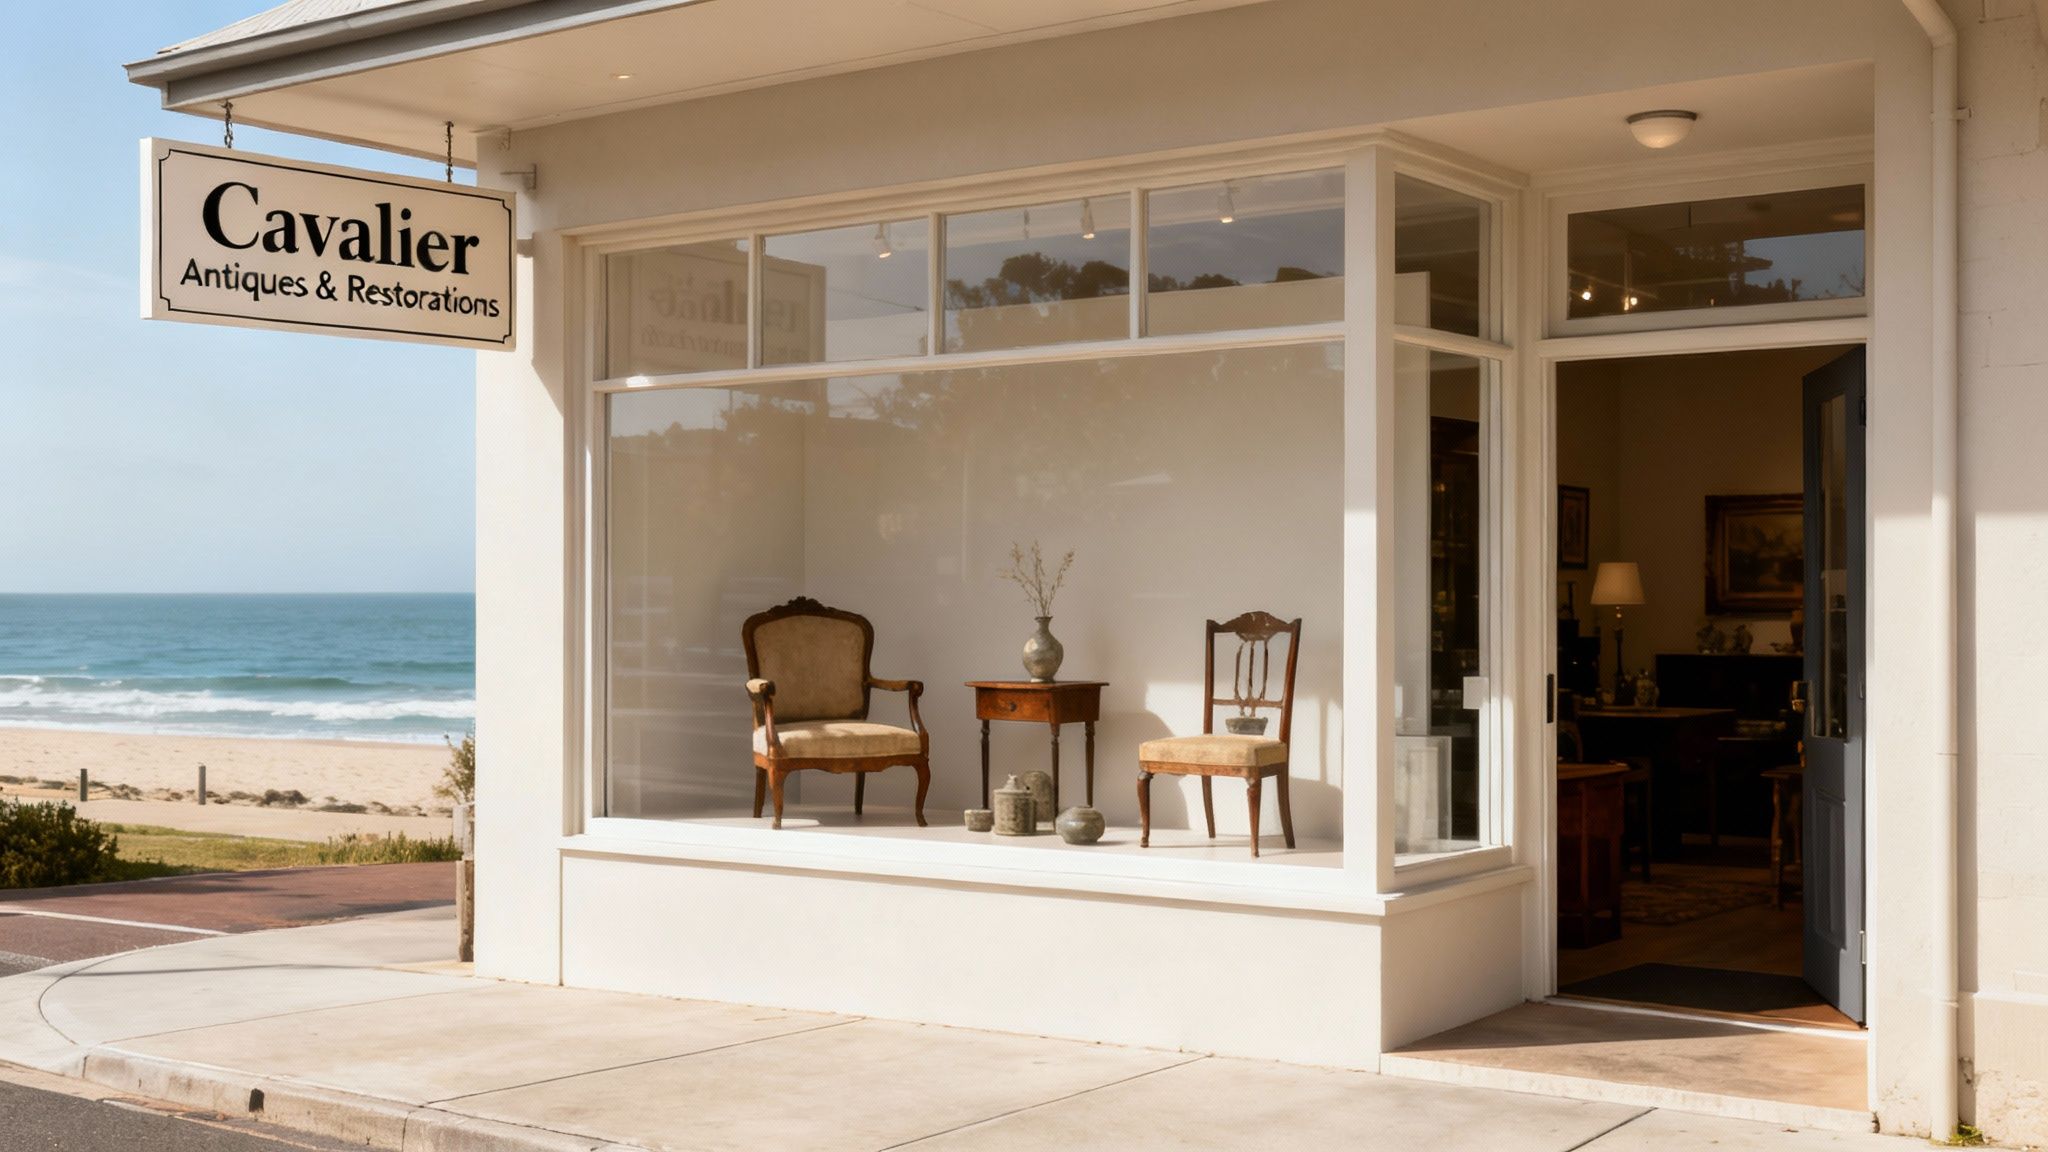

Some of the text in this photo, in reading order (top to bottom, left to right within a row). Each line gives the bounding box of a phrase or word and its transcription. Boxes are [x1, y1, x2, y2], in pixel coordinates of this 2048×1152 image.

[202, 181, 480, 275] Cavalier
[180, 257, 501, 318] Antiques & Restorations
